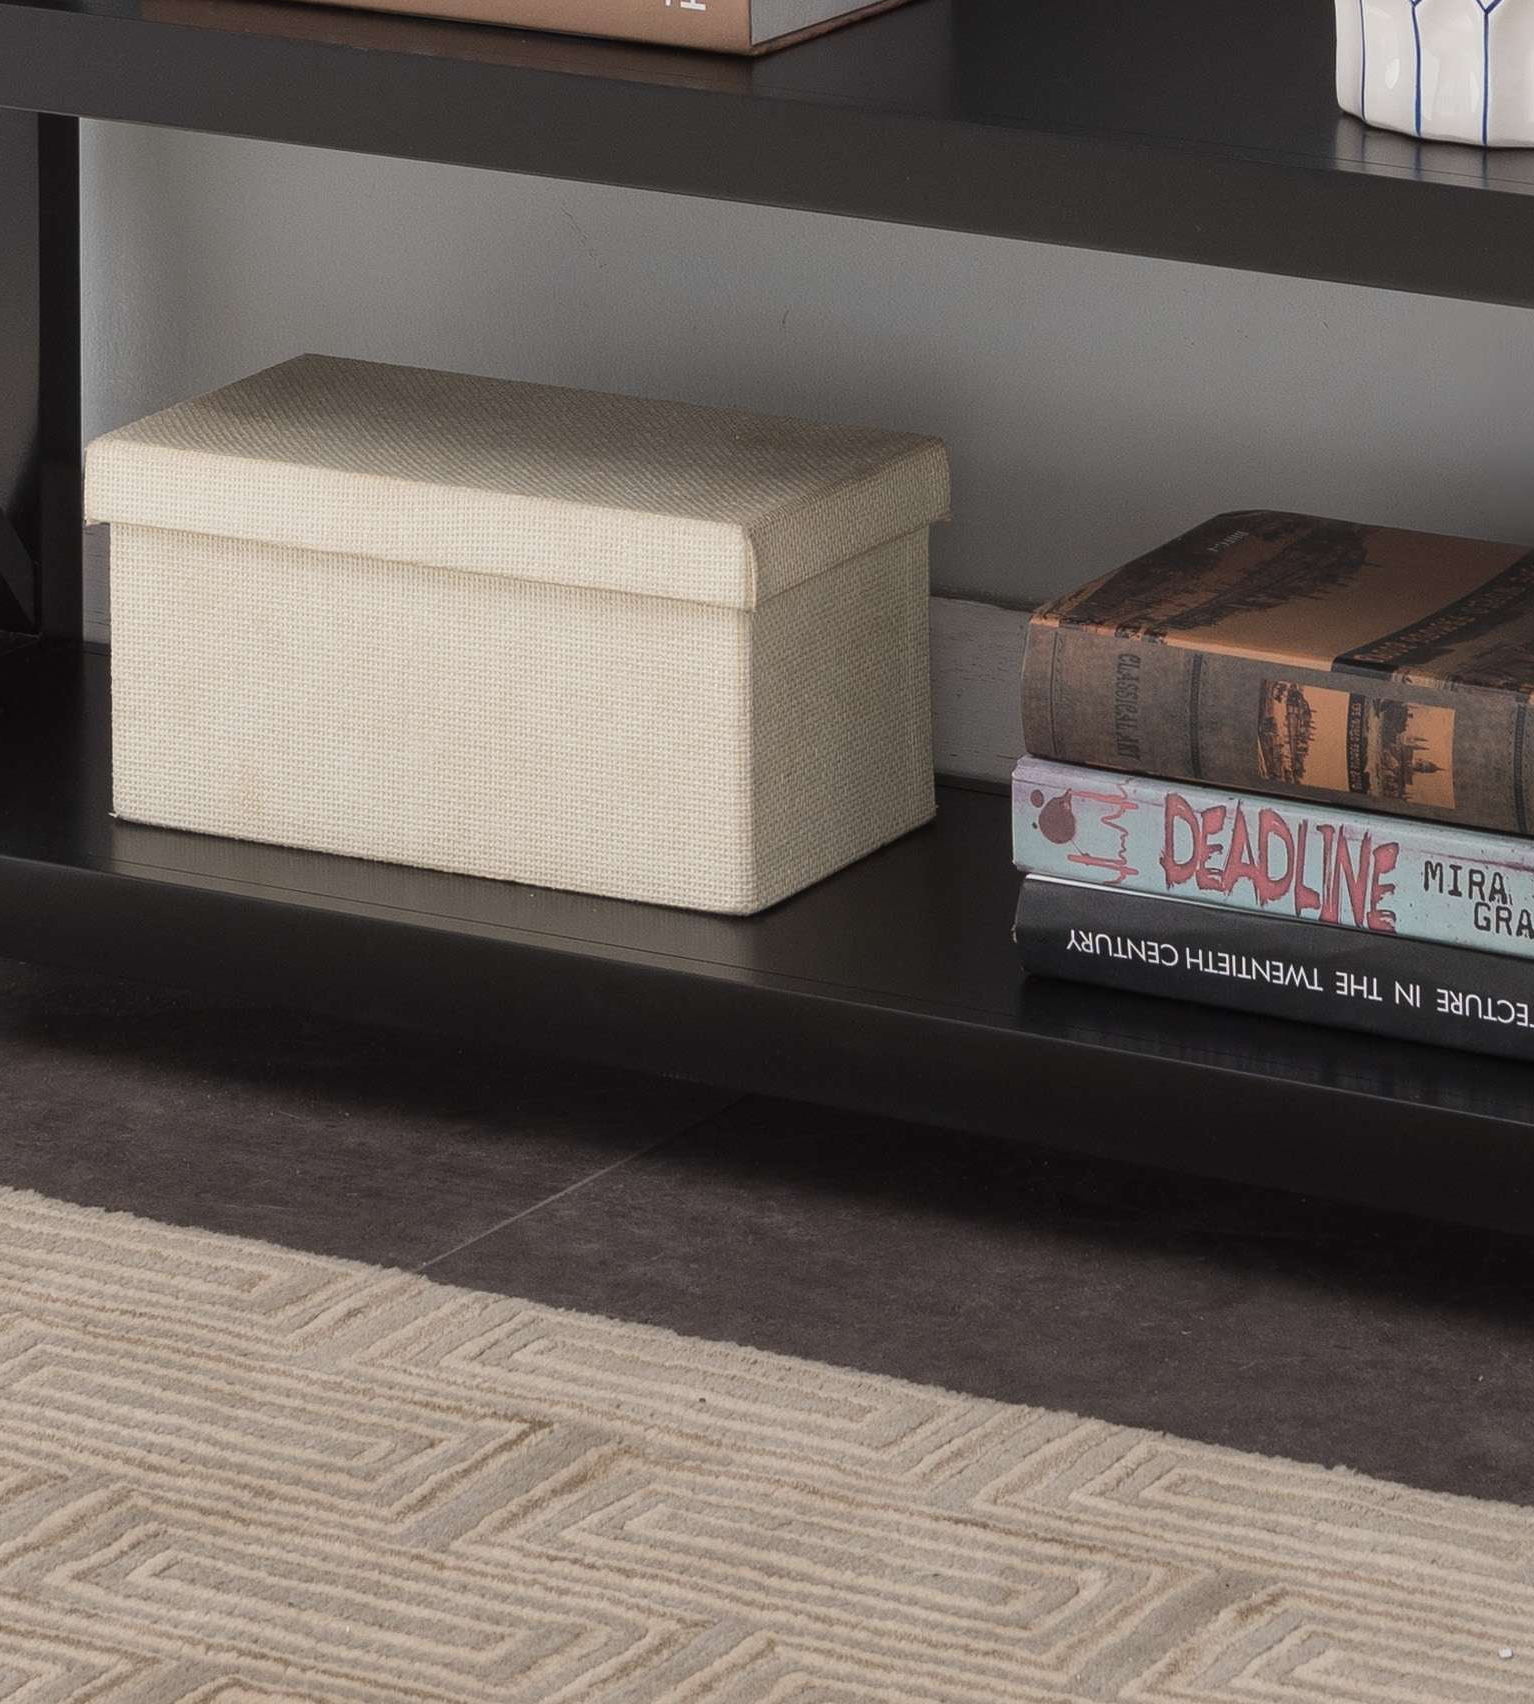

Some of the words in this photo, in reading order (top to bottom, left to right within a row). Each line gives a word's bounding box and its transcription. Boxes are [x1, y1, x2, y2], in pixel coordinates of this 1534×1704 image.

[1159, 792, 1399, 935] DEADLINE
[1423, 860, 1514, 905] MIRA
[1066, 928, 1179, 967] CENTURY
[1186, 947, 1324, 992] TWENTIETH
[1335, 971, 1383, 1001] THE
[1394, 983, 1421, 1008] IN
